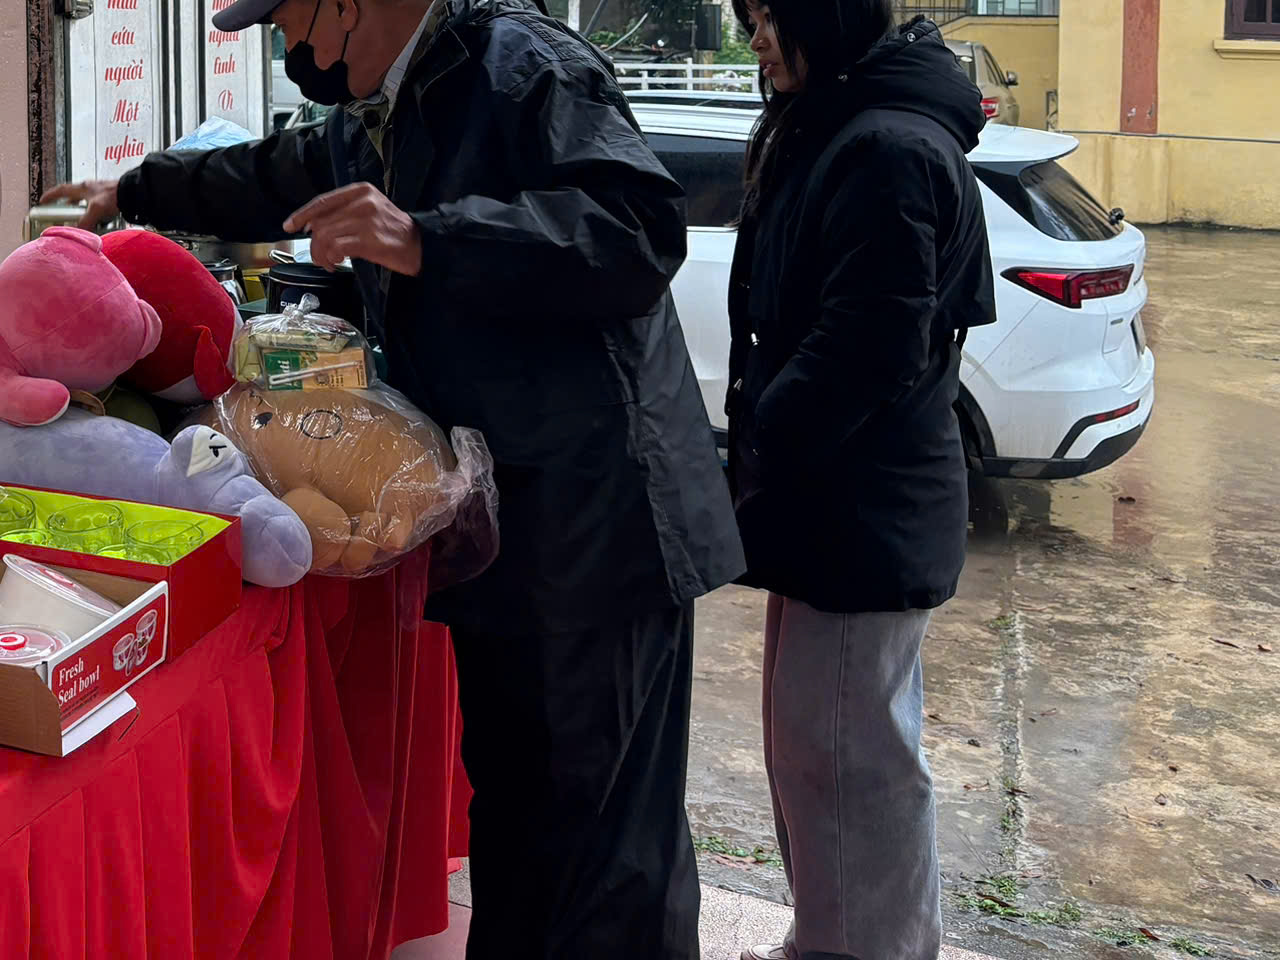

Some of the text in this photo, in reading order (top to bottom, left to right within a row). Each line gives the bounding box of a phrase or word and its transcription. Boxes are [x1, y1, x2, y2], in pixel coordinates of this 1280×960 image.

[111, 26, 135, 46] cứu
[105, 59, 144, 87] người
[110, 99, 139, 127] Một
[105, 135, 145, 165] nghĩa
[59, 657, 84, 686] Fresh
[58, 681, 77, 707] Seal
[79, 665, 100, 693] bowl
